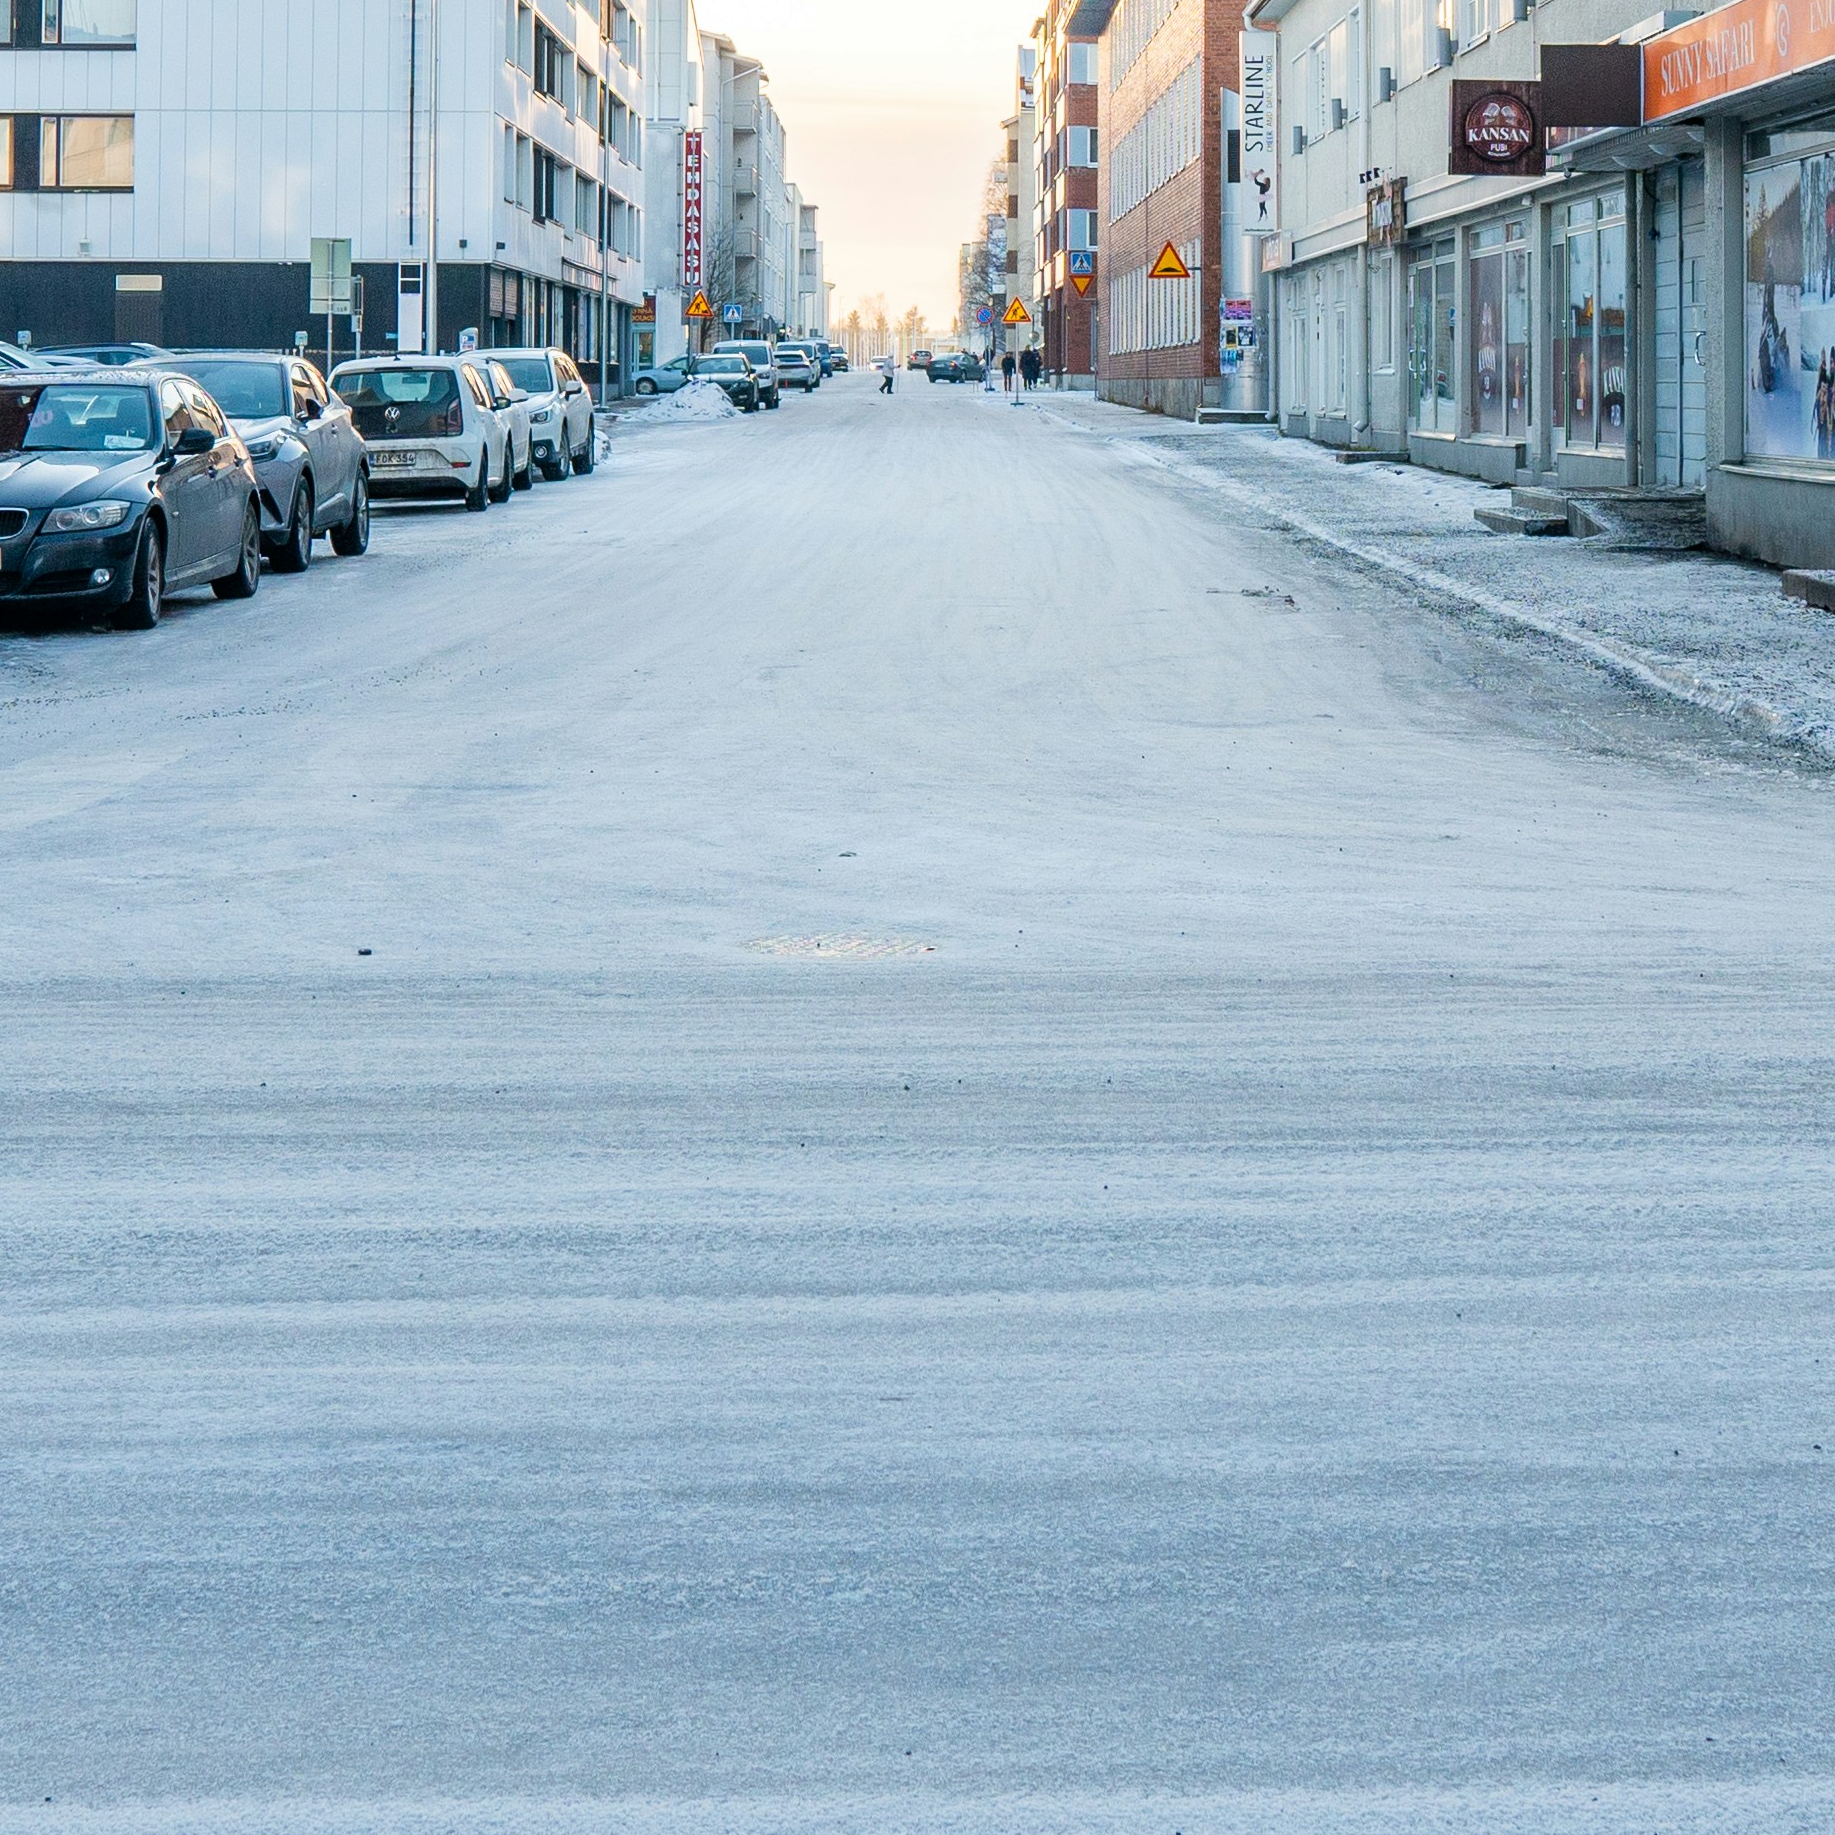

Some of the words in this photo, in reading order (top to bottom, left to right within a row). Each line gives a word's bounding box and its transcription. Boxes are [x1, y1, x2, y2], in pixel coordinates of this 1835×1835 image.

[1661, 40, 1703, 97] SUNNY
[1706, 19, 1755, 80] SAFARI
[1245, 55, 1263, 153] STARLINE
[1468, 126, 1530, 143] KANSAN
